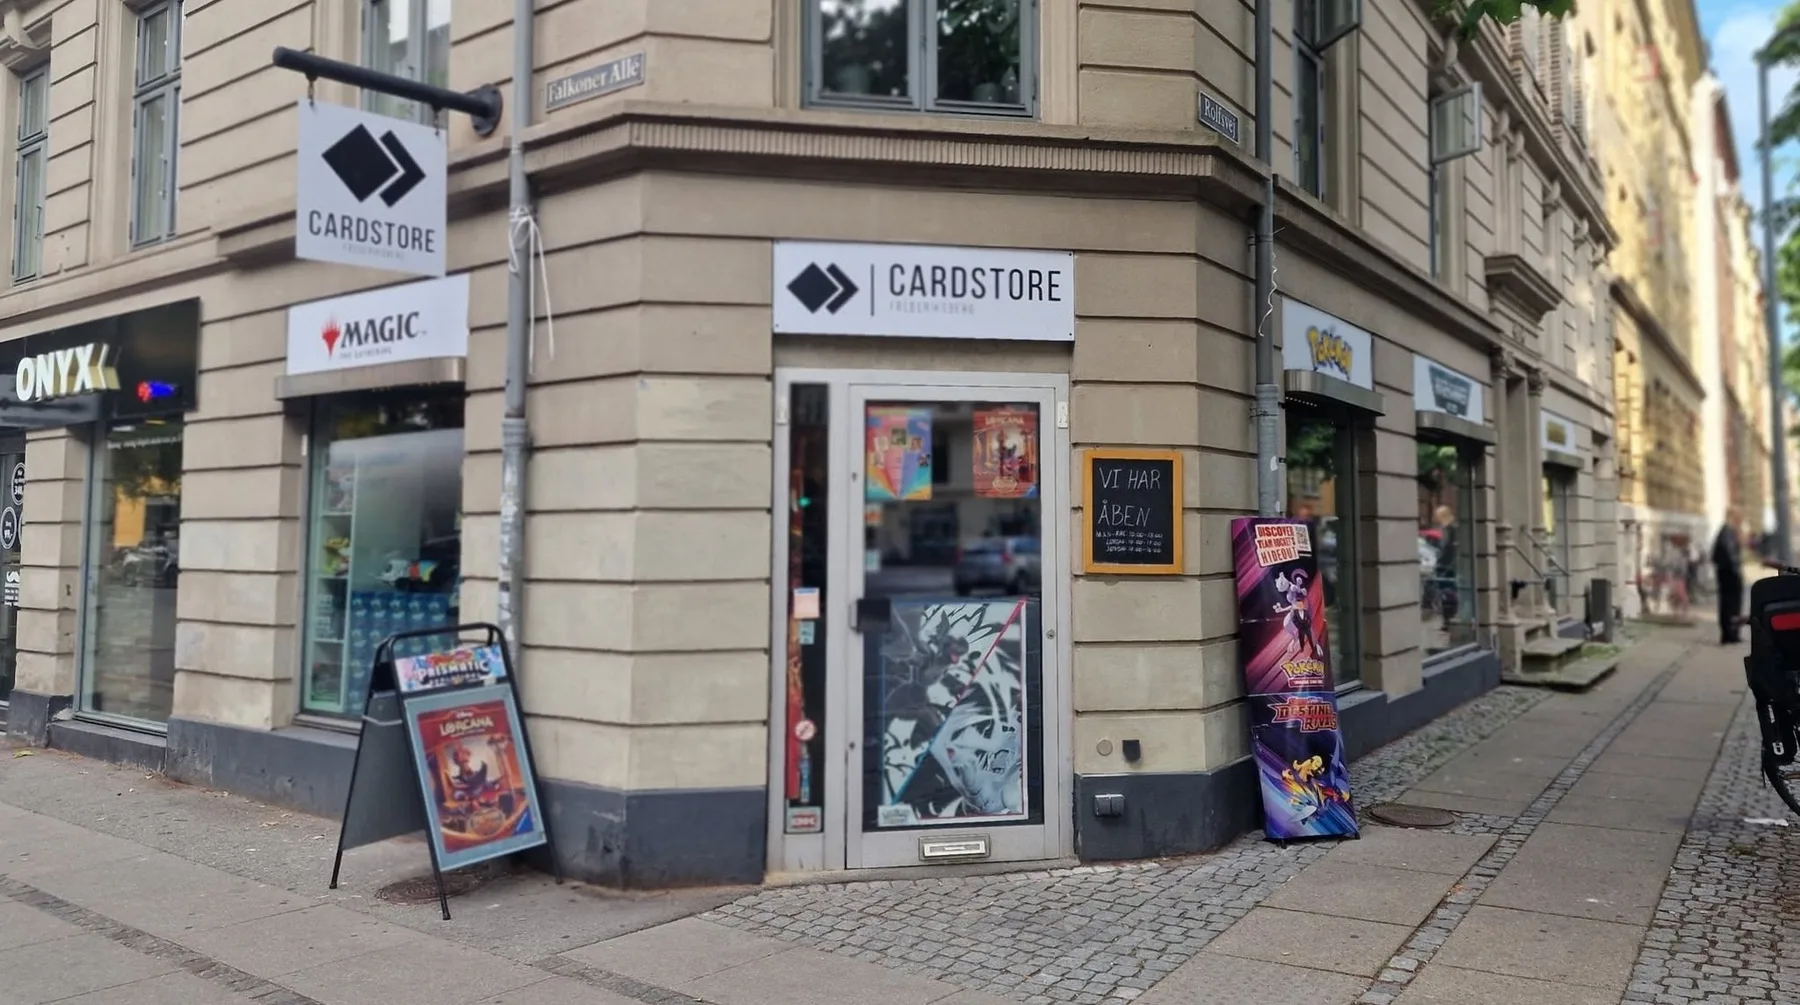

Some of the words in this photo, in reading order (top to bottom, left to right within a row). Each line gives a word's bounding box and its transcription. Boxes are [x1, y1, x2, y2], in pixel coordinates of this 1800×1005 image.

[549, 71, 608, 103] Falkoner
[1204, 97, 1236, 139] Rolfsvej
[308, 209, 436, 253] CARDSTORE
[889, 263, 1062, 302] CARDSTORE
[340, 311, 420, 349] MAGIC
[16, 343, 94, 401] ONYX
[1099, 467, 1122, 489] VI
[1127, 469, 1161, 490] HAR
[1098, 499, 1151, 527] ÅBEN
[1257, 539, 1273, 549] TEAM
[1261, 547, 1297, 564] HIDEOUT
[440, 717, 494, 736] LORCANA
